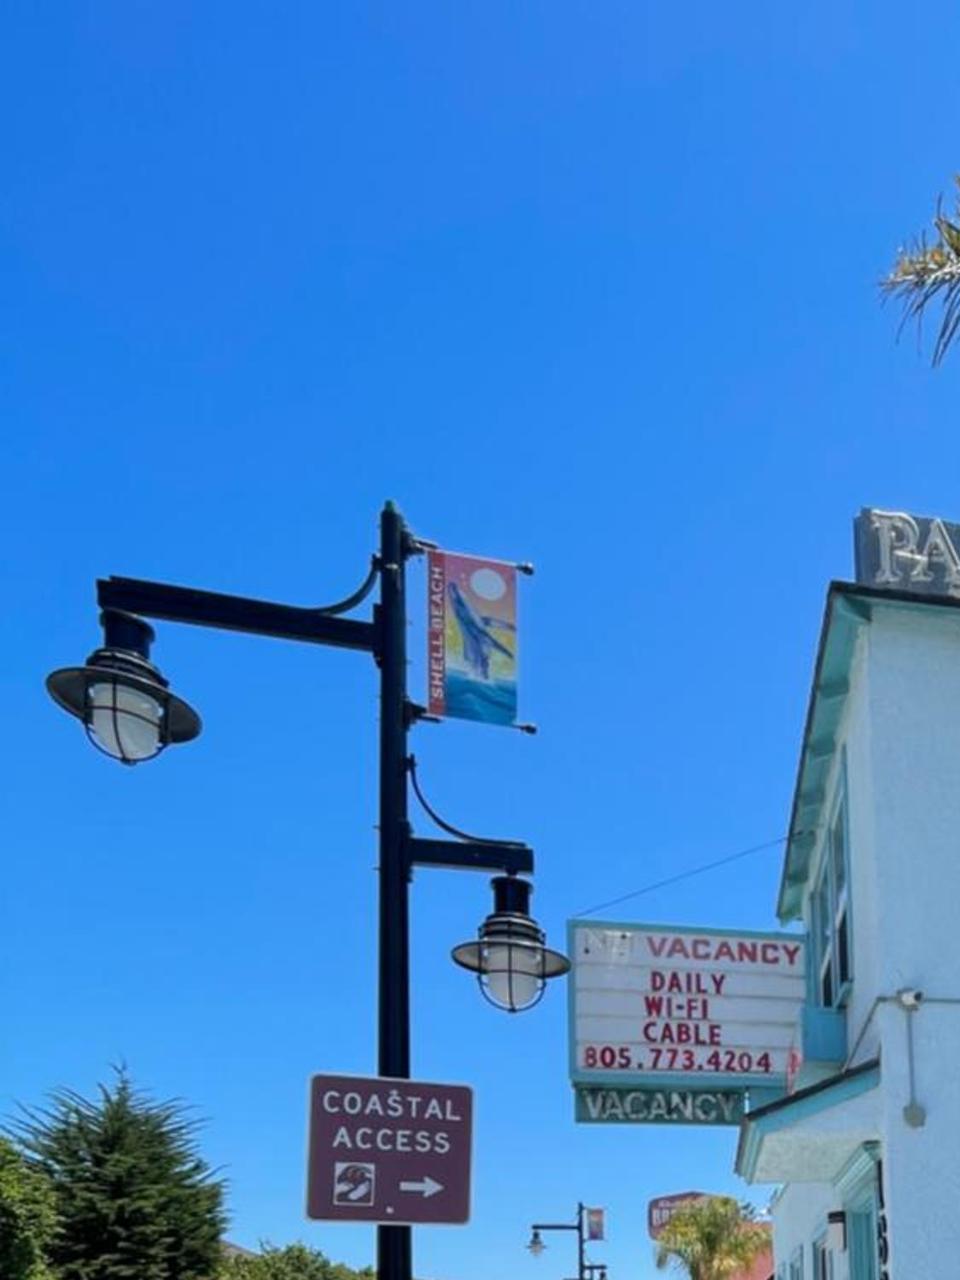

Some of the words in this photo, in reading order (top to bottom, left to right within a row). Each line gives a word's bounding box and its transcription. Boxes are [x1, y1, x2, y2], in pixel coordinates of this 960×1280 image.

[431, 567, 443, 629] BEACH
[431, 634, 443, 698] SHELL
[646, 936, 801, 966] VACANCY
[651, 971, 726, 995] DAILY
[644, 996, 709, 1019] WI-FI
[643, 1021, 722, 1046] CABLE
[583, 1046, 772, 1074] 805.773.4204
[323, 1090, 462, 1121] COASTAL
[583, 1090, 738, 1121] VACANCY
[332, 1126, 450, 1154] ACCESS
